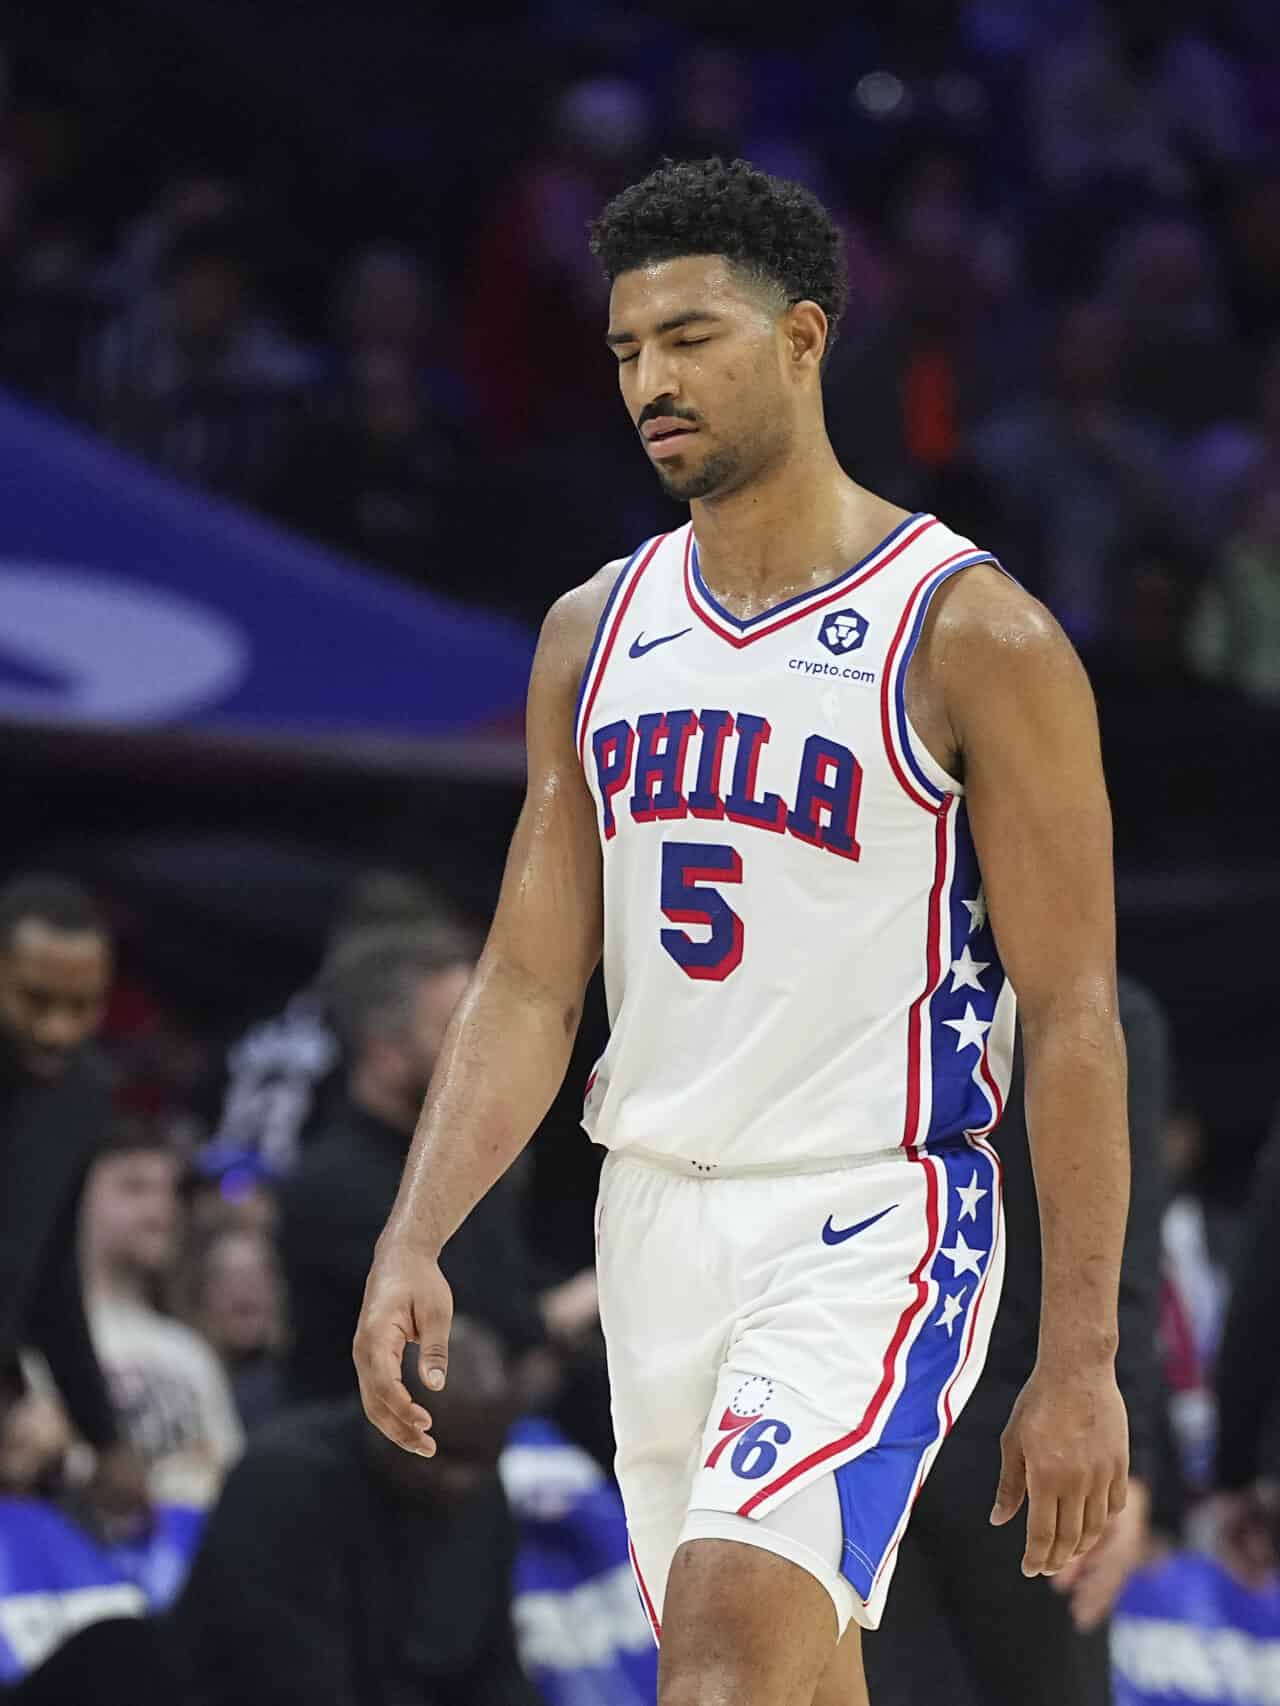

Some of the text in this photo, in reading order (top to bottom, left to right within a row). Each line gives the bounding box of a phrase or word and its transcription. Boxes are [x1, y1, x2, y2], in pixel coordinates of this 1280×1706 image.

[788, 658, 875, 684] crypto.com
[592, 708, 864, 862] PHILA
[660, 841, 744, 982] 5
[703, 1405, 792, 1480] 76
